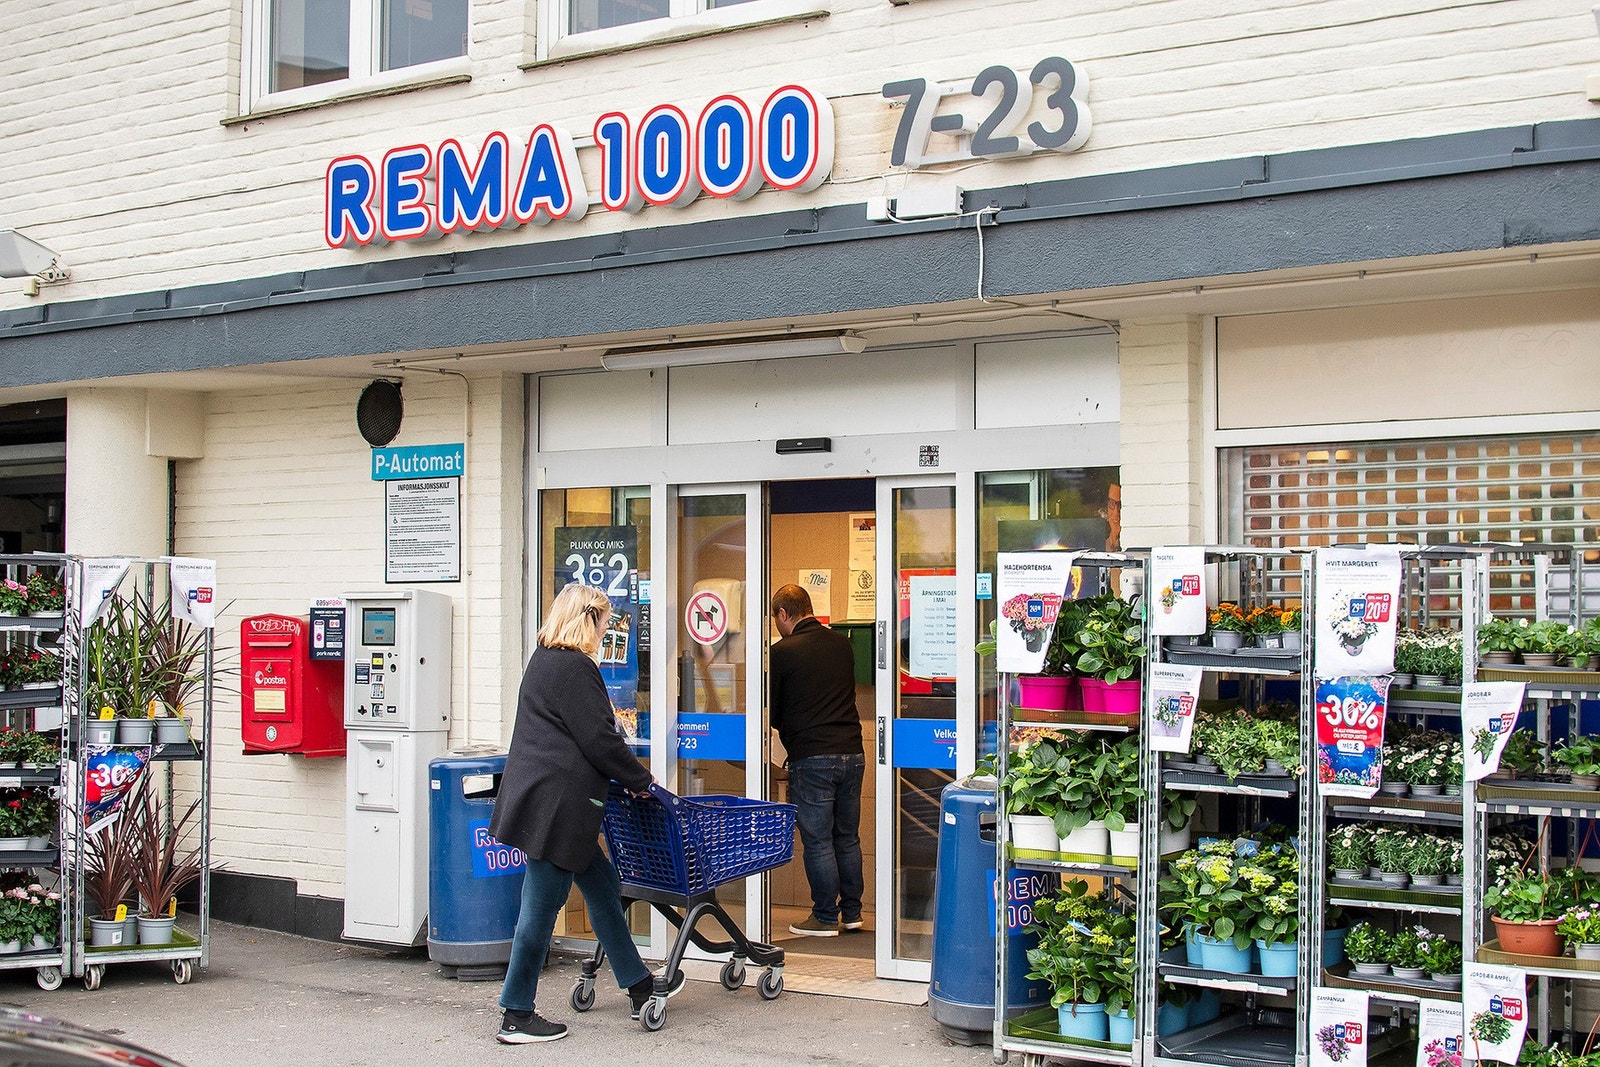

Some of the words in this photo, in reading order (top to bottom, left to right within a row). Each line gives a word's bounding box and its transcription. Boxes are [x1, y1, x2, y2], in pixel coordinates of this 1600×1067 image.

[882, 56, 1080, 168] 7-23
[325, 124, 573, 249] REMA
[594, 85, 820, 212] 1000
[375, 450, 462, 474] P-Automat
[397, 482, 450, 491] INFORMASJONSSKILT
[570, 540, 593, 550] PLUKK
[594, 541, 605, 549] OG
[606, 540, 624, 549] MIKS
[565, 553, 586, 585] 3
[589, 552, 605, 588] OR
[608, 553, 629, 596] 2
[810, 573, 828, 586] Mai
[1044, 605, 1055, 620] 174
[1352, 603, 1359, 613] 29
[1366, 602, 1380, 619] 20
[264, 676, 286, 686] posten
[1320, 694, 1378, 729] -30%
[933, 728, 957, 739] Velko
[677, 738, 697, 749] 7-23
[1008, 904, 1043, 929] 10
[1504, 1005, 1515, 1017] 160
[1346, 1029, 1356, 1041] 48
